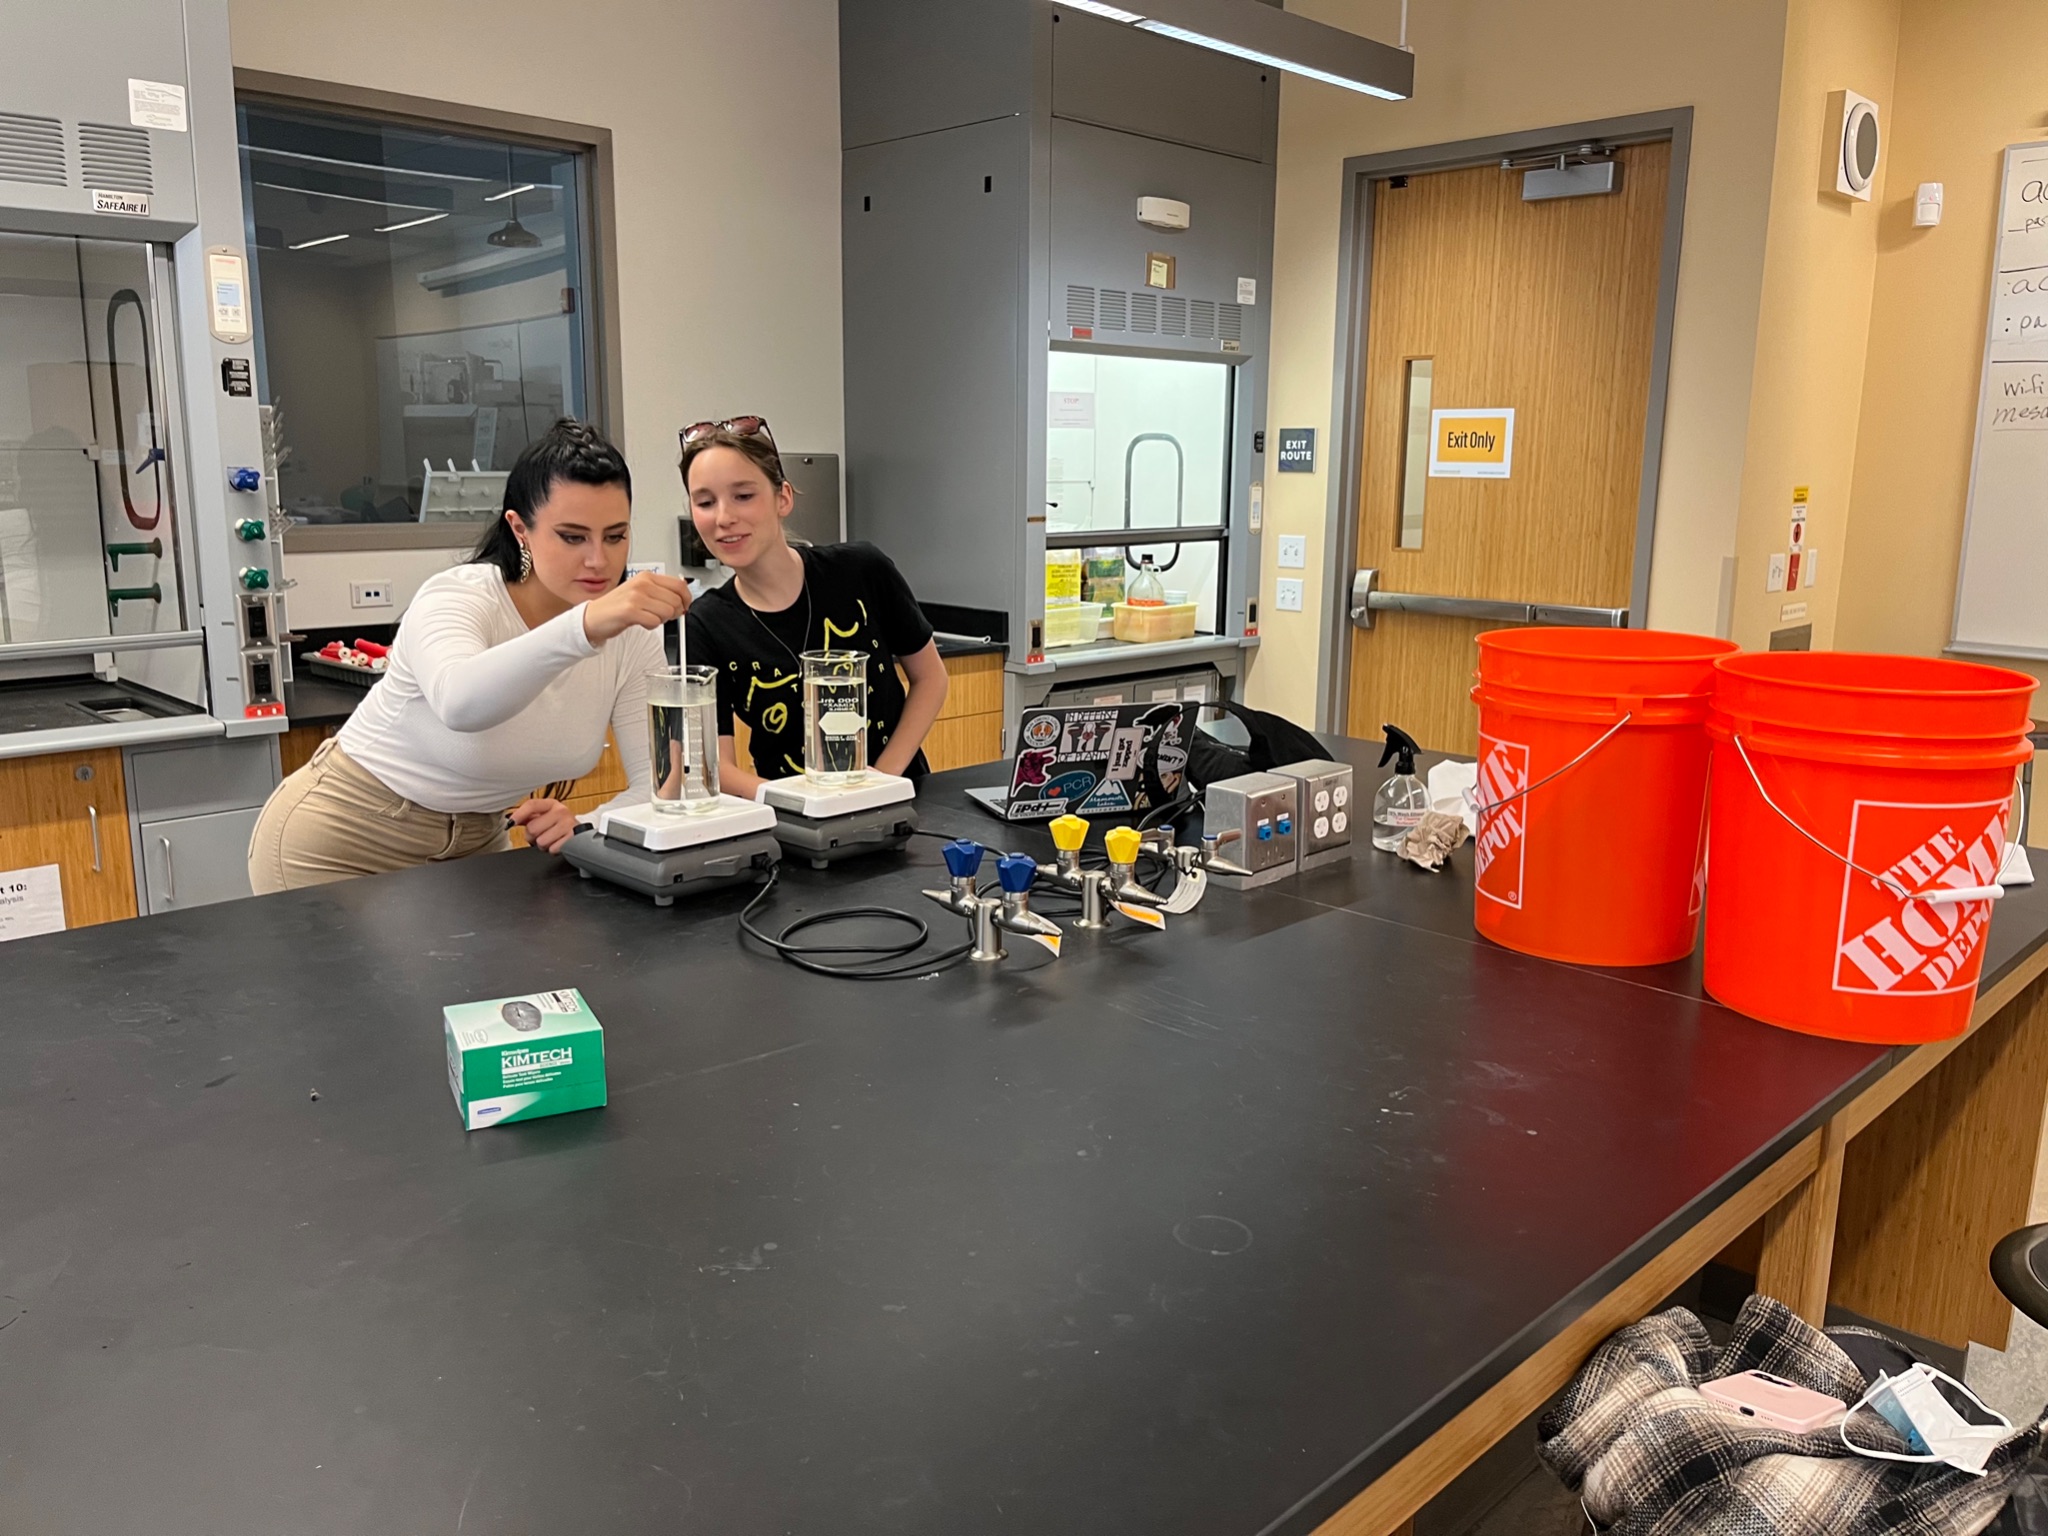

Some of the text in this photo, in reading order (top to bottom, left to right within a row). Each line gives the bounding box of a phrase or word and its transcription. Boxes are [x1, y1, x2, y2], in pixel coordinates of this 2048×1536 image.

[1286, 440, 1307, 450] EXIT
[1447, 430, 1496, 453] Exit Only
[1280, 451, 1312, 461] ROUTE
[1063, 776, 1092, 793] PCR
[1476, 804, 1523, 886] EPOT
[1870, 825, 1966, 902] THE
[9, 883, 27, 892] 10:
[1921, 898, 1990, 991] DEPO
[502, 1046, 573, 1068] KIMTECH
